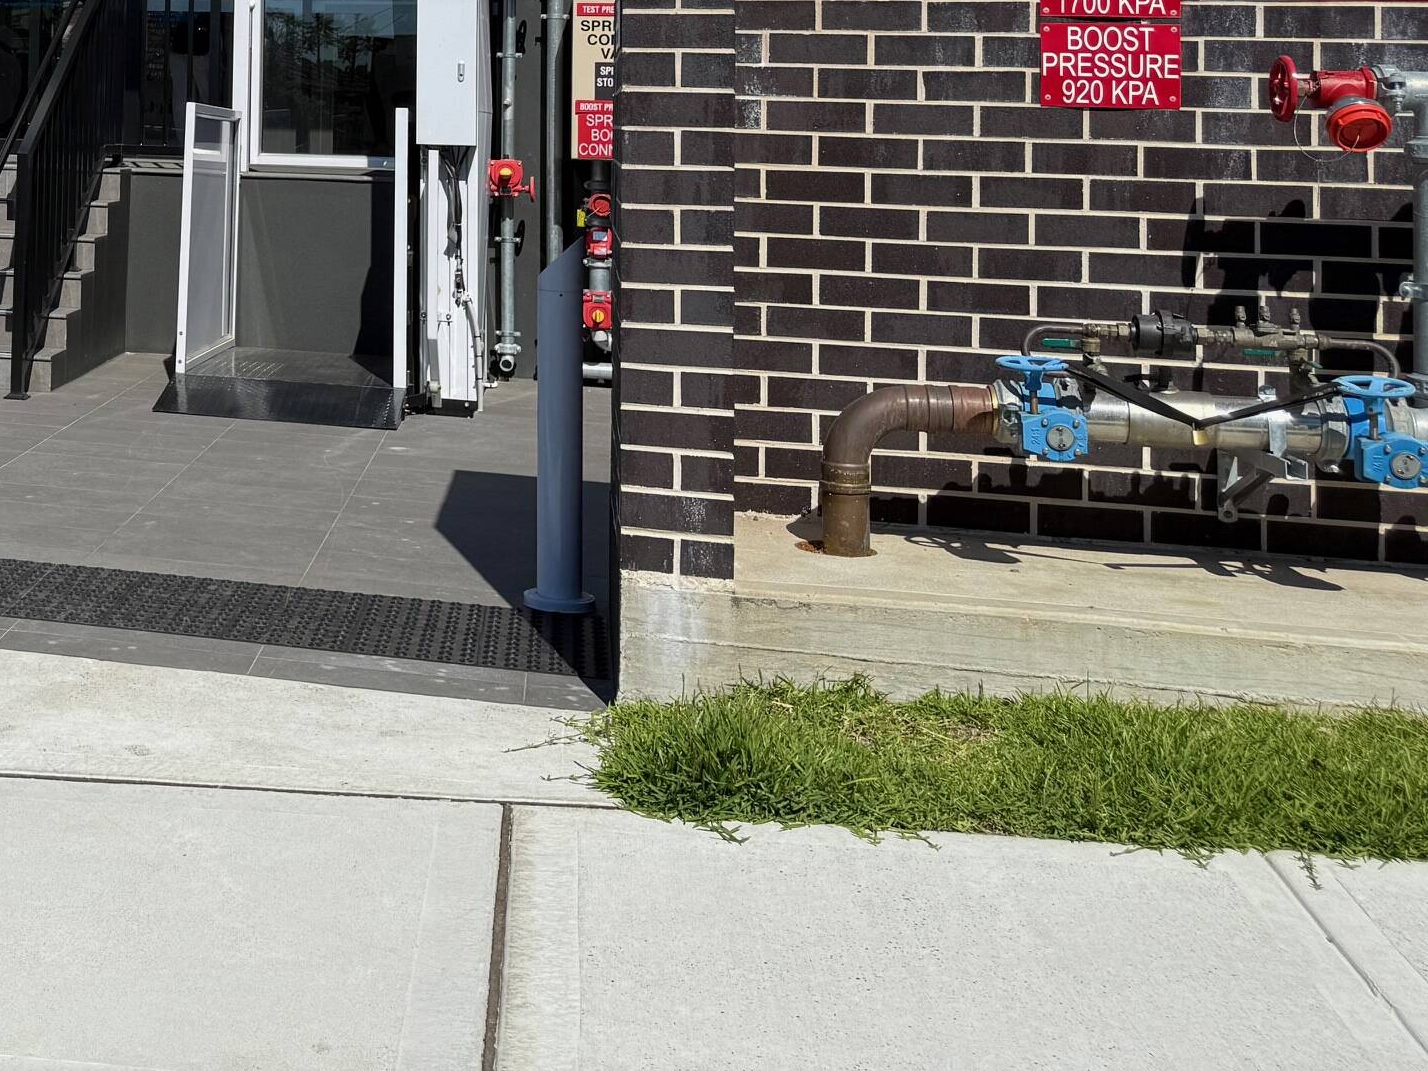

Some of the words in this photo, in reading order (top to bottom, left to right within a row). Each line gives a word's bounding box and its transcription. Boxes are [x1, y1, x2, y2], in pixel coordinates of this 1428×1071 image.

[582, 5, 600, 14] TEST
[1067, 25, 1155, 52] BOOST
[1042, 53, 1180, 79] PRESSURE
[1062, 80, 1106, 105] 920
[1111, 81, 1160, 106] KPA
[579, 102, 603, 111] BOOST
